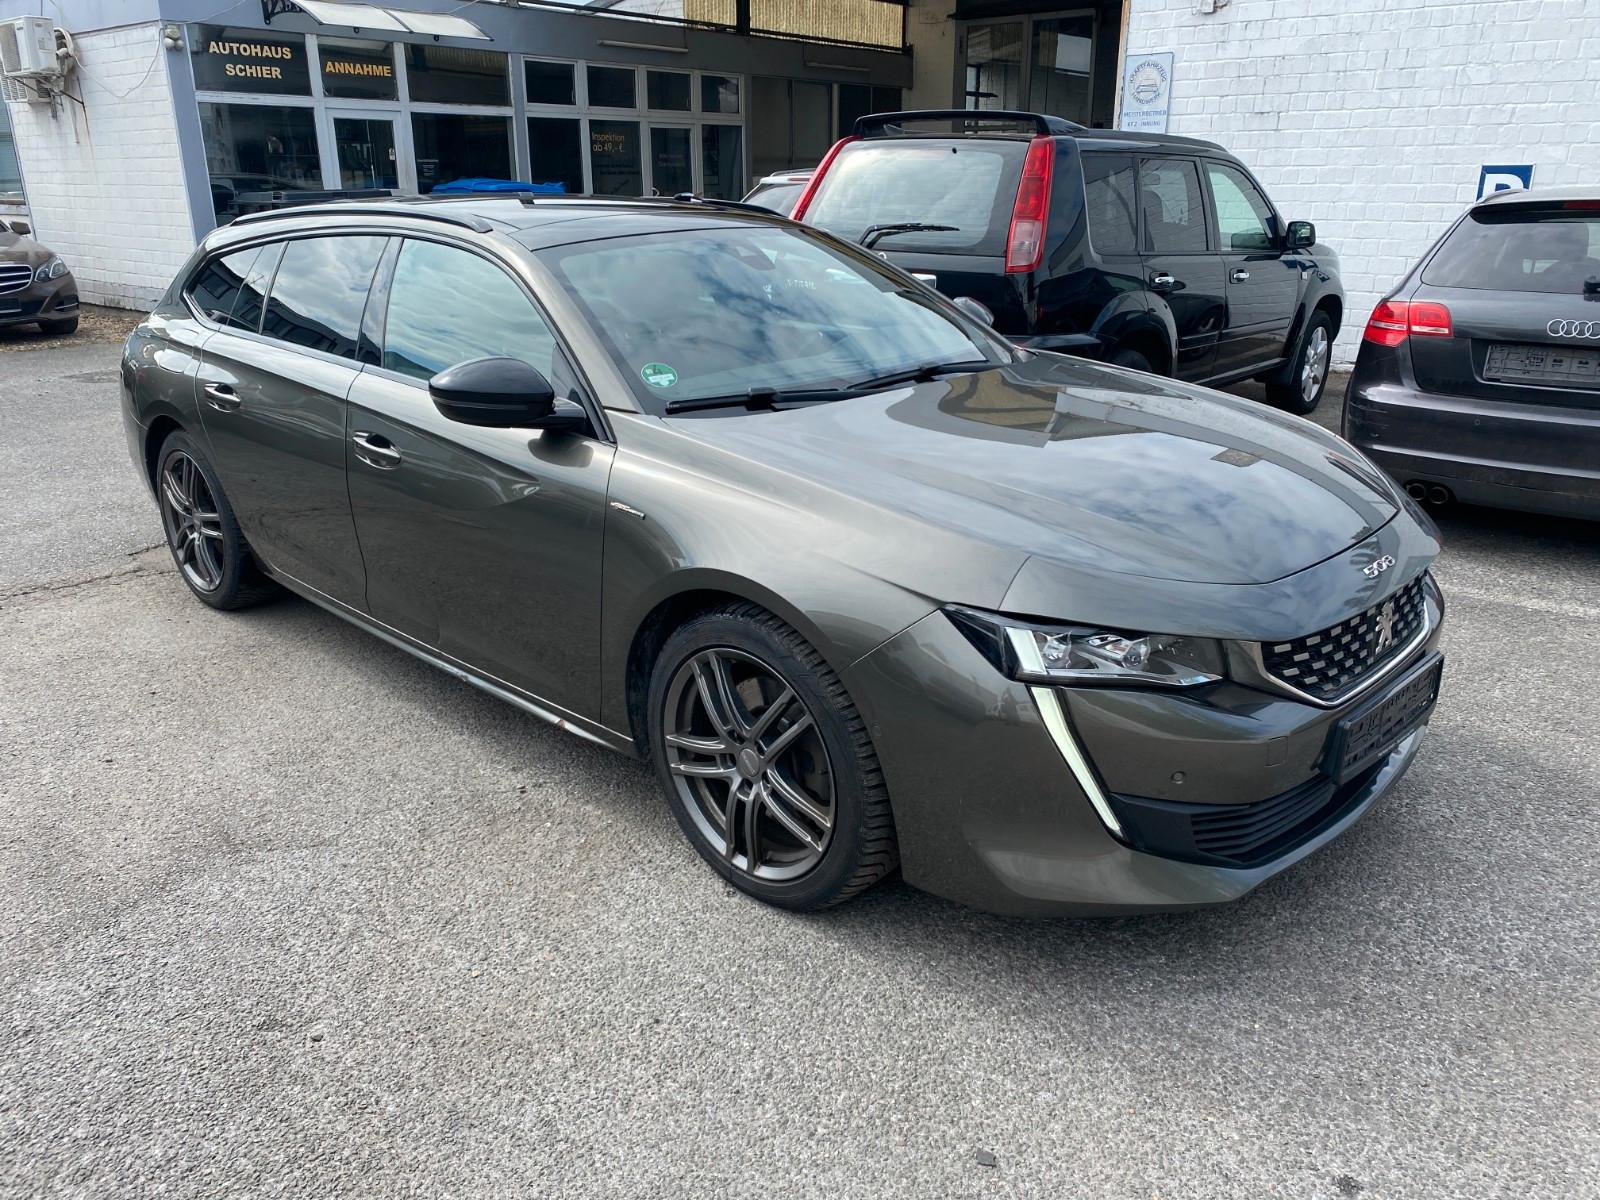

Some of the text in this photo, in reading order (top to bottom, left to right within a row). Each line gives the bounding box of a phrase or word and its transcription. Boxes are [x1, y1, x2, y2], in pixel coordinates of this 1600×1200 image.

[208, 41, 292, 59] AUTOHAUS
[225, 63, 282, 79] SCHIER
[325, 61, 392, 77] ANNAHME
[592, 131, 625, 142] Inspektion
[1363, 554, 1396, 578] 508
